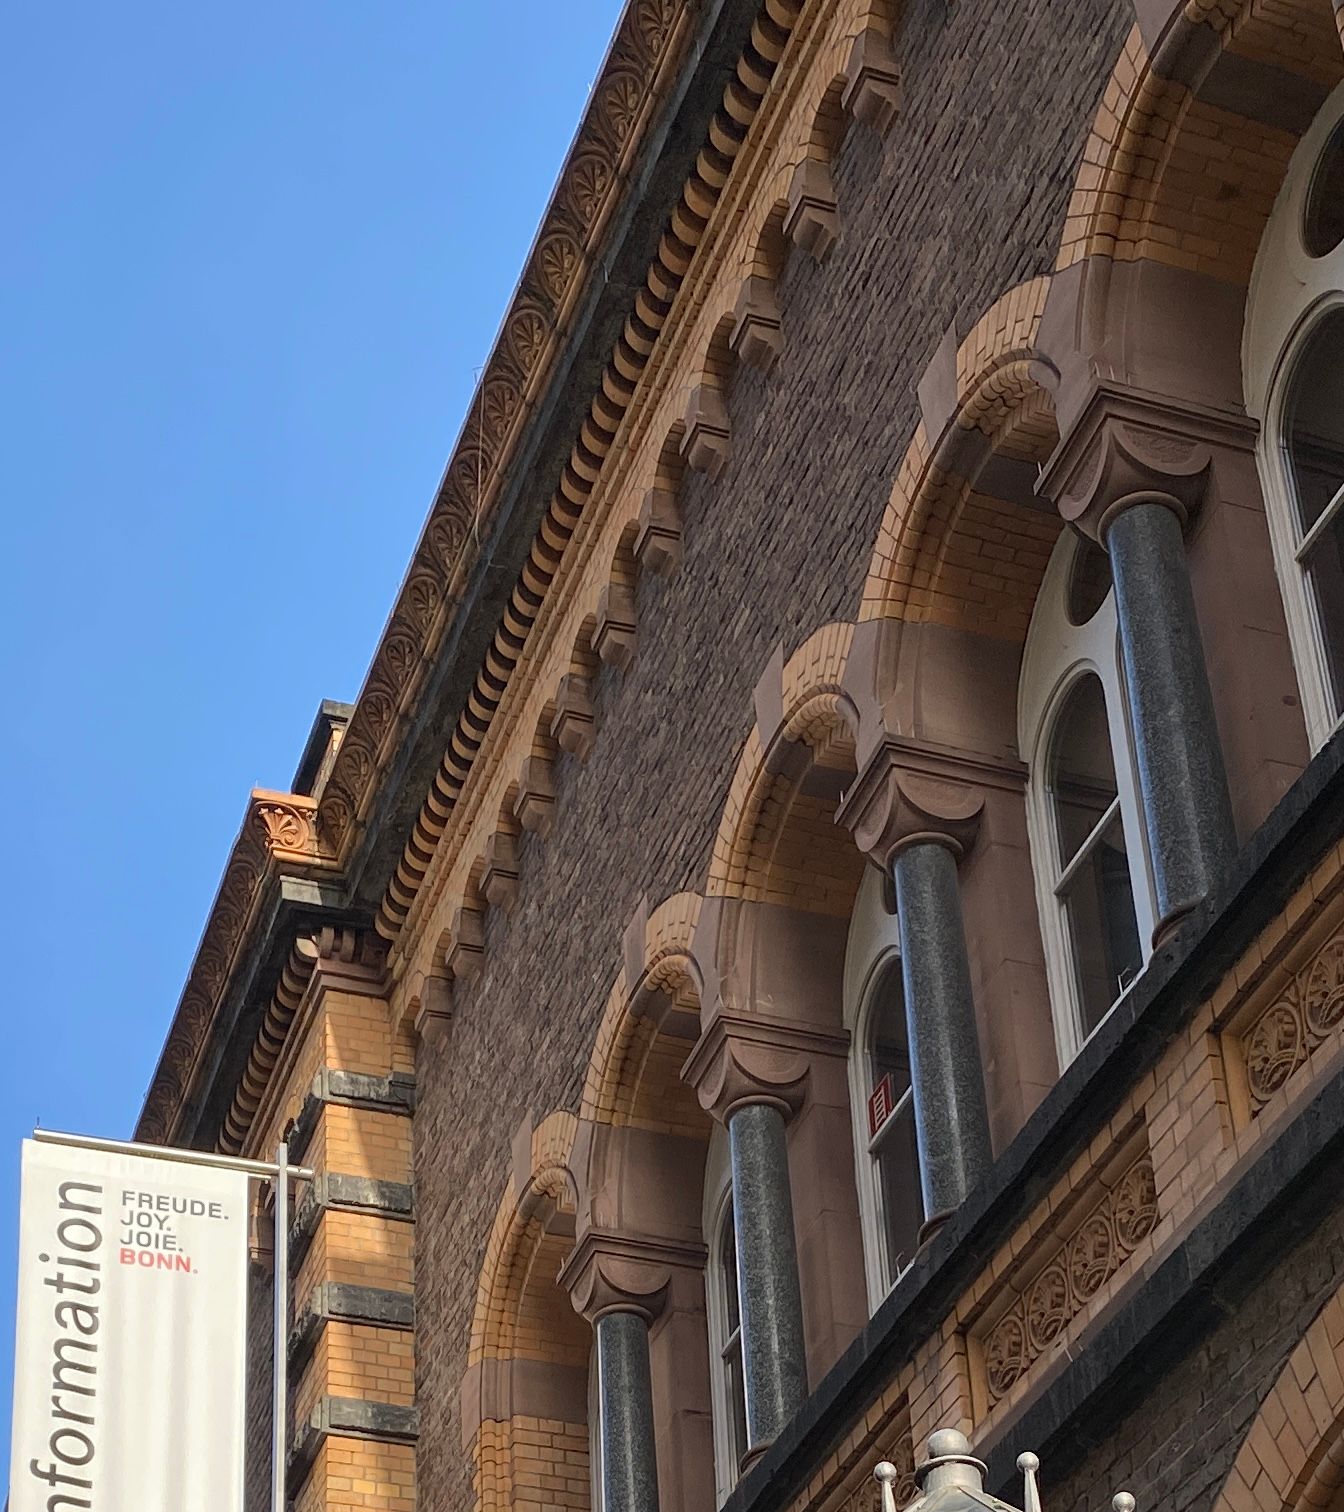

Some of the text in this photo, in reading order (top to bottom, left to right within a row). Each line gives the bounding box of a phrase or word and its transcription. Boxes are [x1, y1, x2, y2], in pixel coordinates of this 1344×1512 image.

[121, 1190, 230, 1219] FREUDE.
[119, 1210, 172, 1231] JOY.
[119, 1229, 184, 1252] JOIE.
